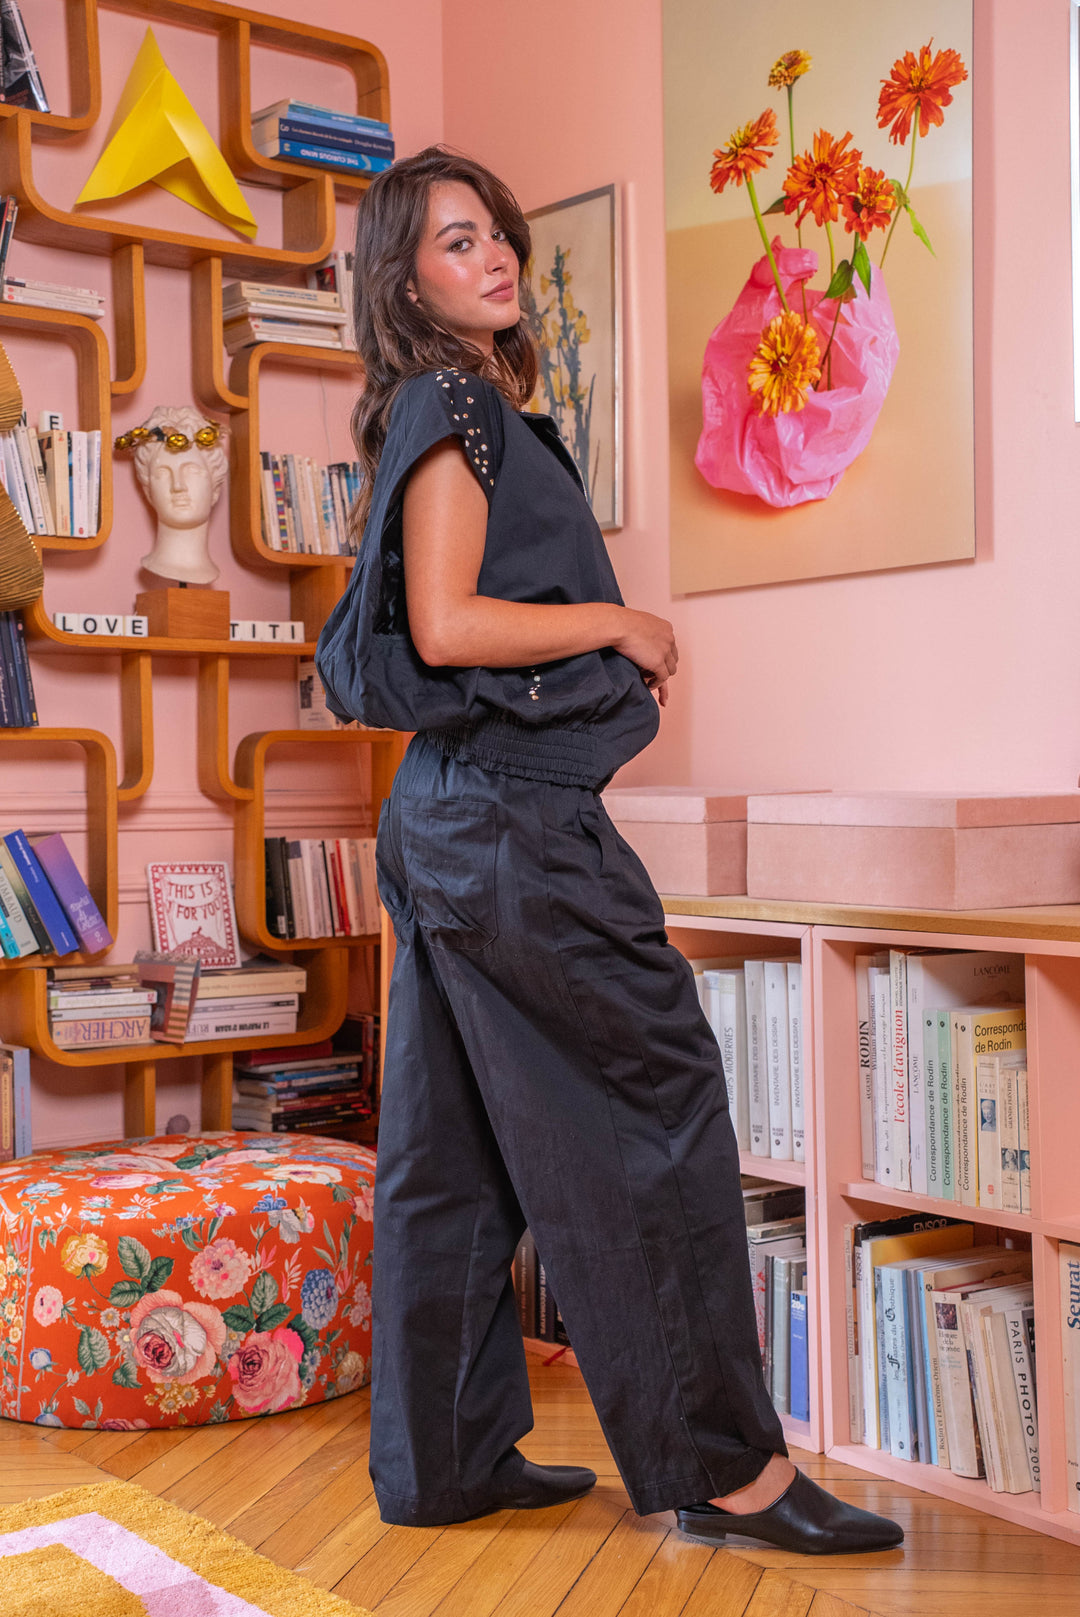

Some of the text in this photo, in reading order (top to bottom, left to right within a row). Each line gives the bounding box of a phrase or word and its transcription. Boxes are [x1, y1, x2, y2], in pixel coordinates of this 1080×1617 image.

[62, 616, 143, 635] LOVE
[230, 623, 295, 640] TITI
[168, 881, 213, 899] THIS IS
[176, 899, 221, 921] FOR YOU
[80, 1019, 147, 1041] ARCHER
[974, 1020, 1027, 1037] Corresponda
[724, 1026, 735, 1075] MODERNES
[859, 1020, 870, 1069] RODIN
[975, 1039, 1012, 1054] de Rodin
[893, 1009, 906, 1123] l'école d'avignon
[752, 1066, 760, 1104] INVENTAIRE
[793, 1067, 801, 1108] INVENTAIRE
[928, 1089, 935, 1102] de
[941, 1091, 949, 1104] de
[961, 1105, 968, 1117] de
[928, 1104, 937, 1182] Correspondance
[941, 1107, 951, 1186] Correspondance
[961, 1120, 970, 1191] Correspondance
[1066, 1260, 1080, 1330] Seurat
[1009, 1320, 1040, 1482] PARIS PHOTO 2003
